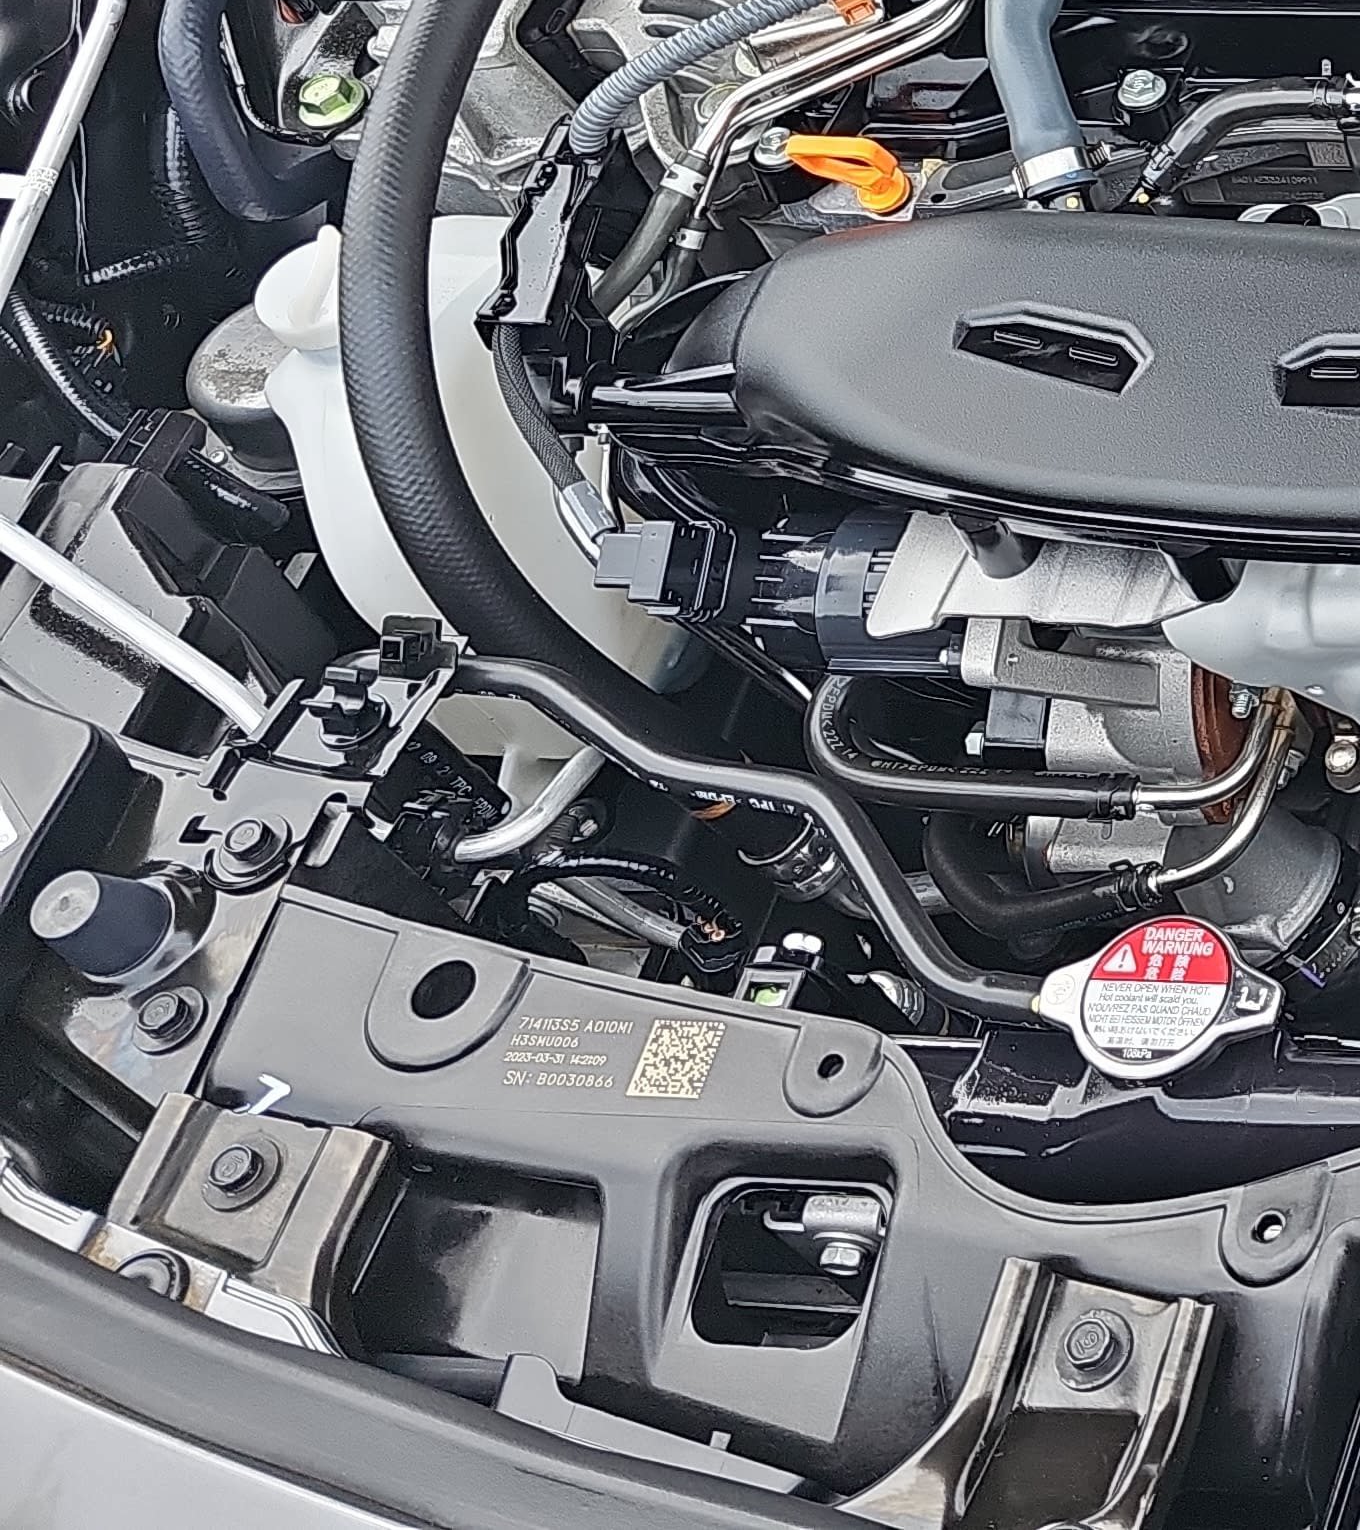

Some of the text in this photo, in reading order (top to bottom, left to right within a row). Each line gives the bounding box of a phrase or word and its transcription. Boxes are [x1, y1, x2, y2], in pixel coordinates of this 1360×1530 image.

[1144, 926, 1204, 942] DANGER
[1141, 940, 1214, 956] WARNUNG
[1101, 983, 1210, 996] NEVER OPEN WHEN HOT.
[1098, 993, 1113, 1002] Hot
[1115, 994, 1143, 1003] coolant
[1145, 995, 1158, 1003] will
[1159, 995, 1180, 1004] scald
[1131, 1004, 1147, 1014] PAS
[1150, 1005, 1180, 1015] QUAND
[1088, 1013, 1109, 1023] NICHT
[1152, 1016, 1177, 1025] MOTOR
[503, 1051, 564, 1064] 2023-03-31
[503, 1069, 614, 1089] SN: B0030866
